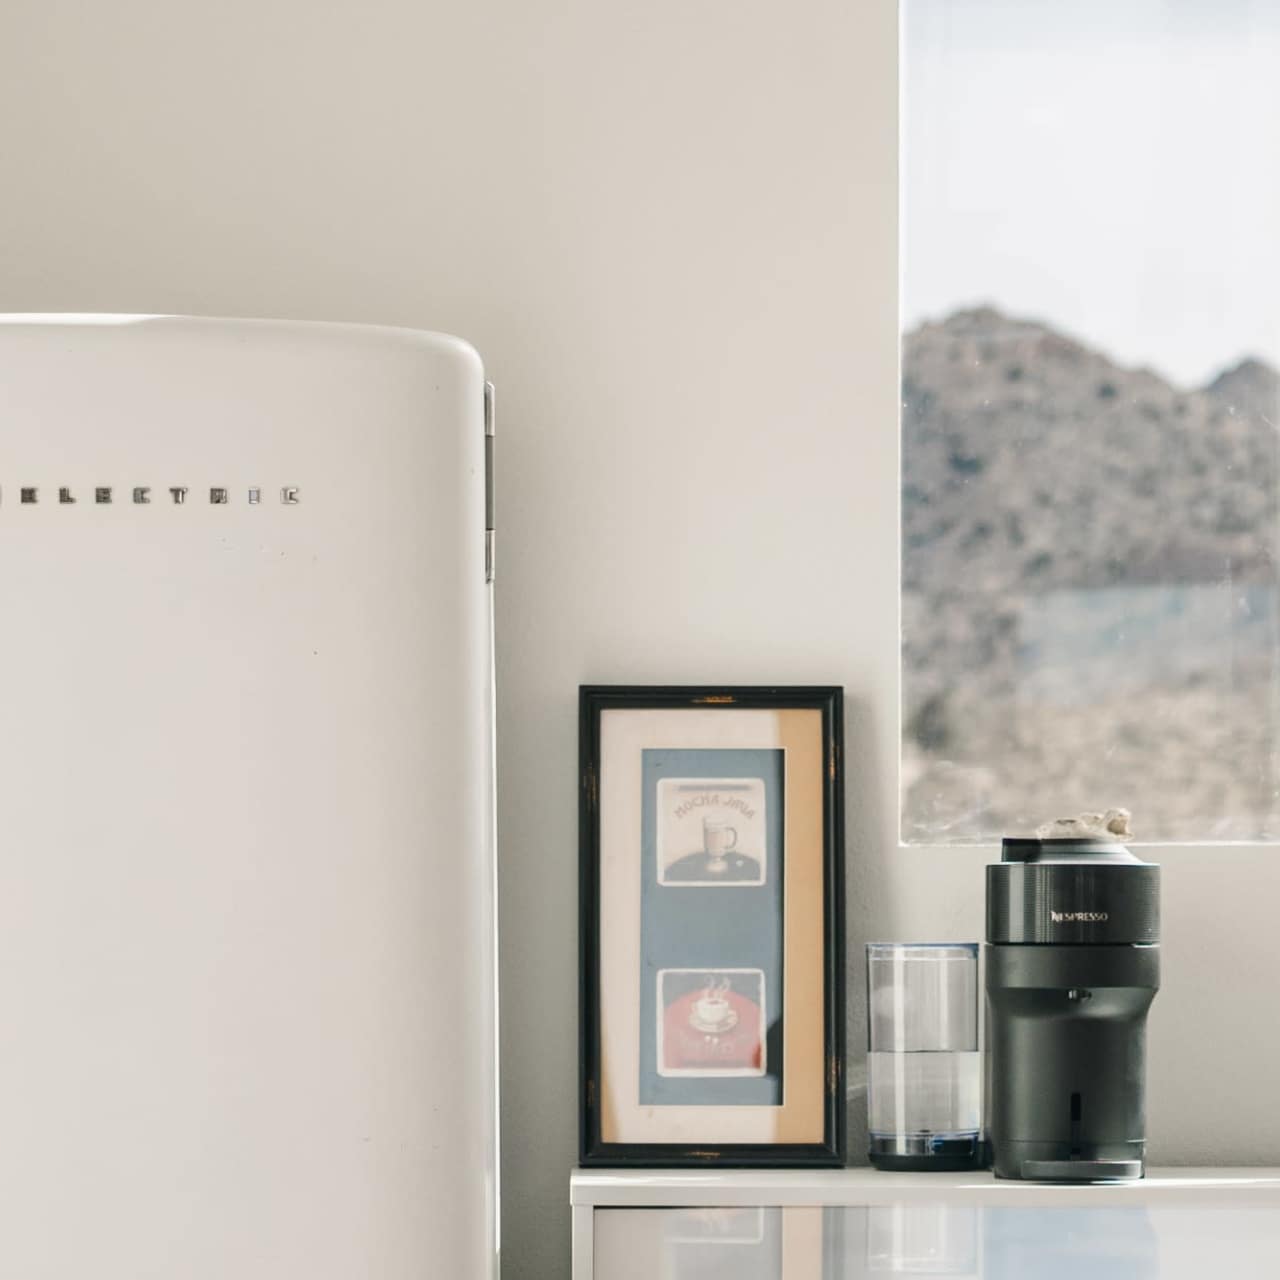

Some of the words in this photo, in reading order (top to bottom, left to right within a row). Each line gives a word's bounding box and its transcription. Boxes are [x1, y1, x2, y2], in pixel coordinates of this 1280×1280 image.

[20, 486, 299, 505] ELECTRIC
[674, 795, 720, 819] MOCHA
[1050, 910, 1109, 922] NESPRESSO
